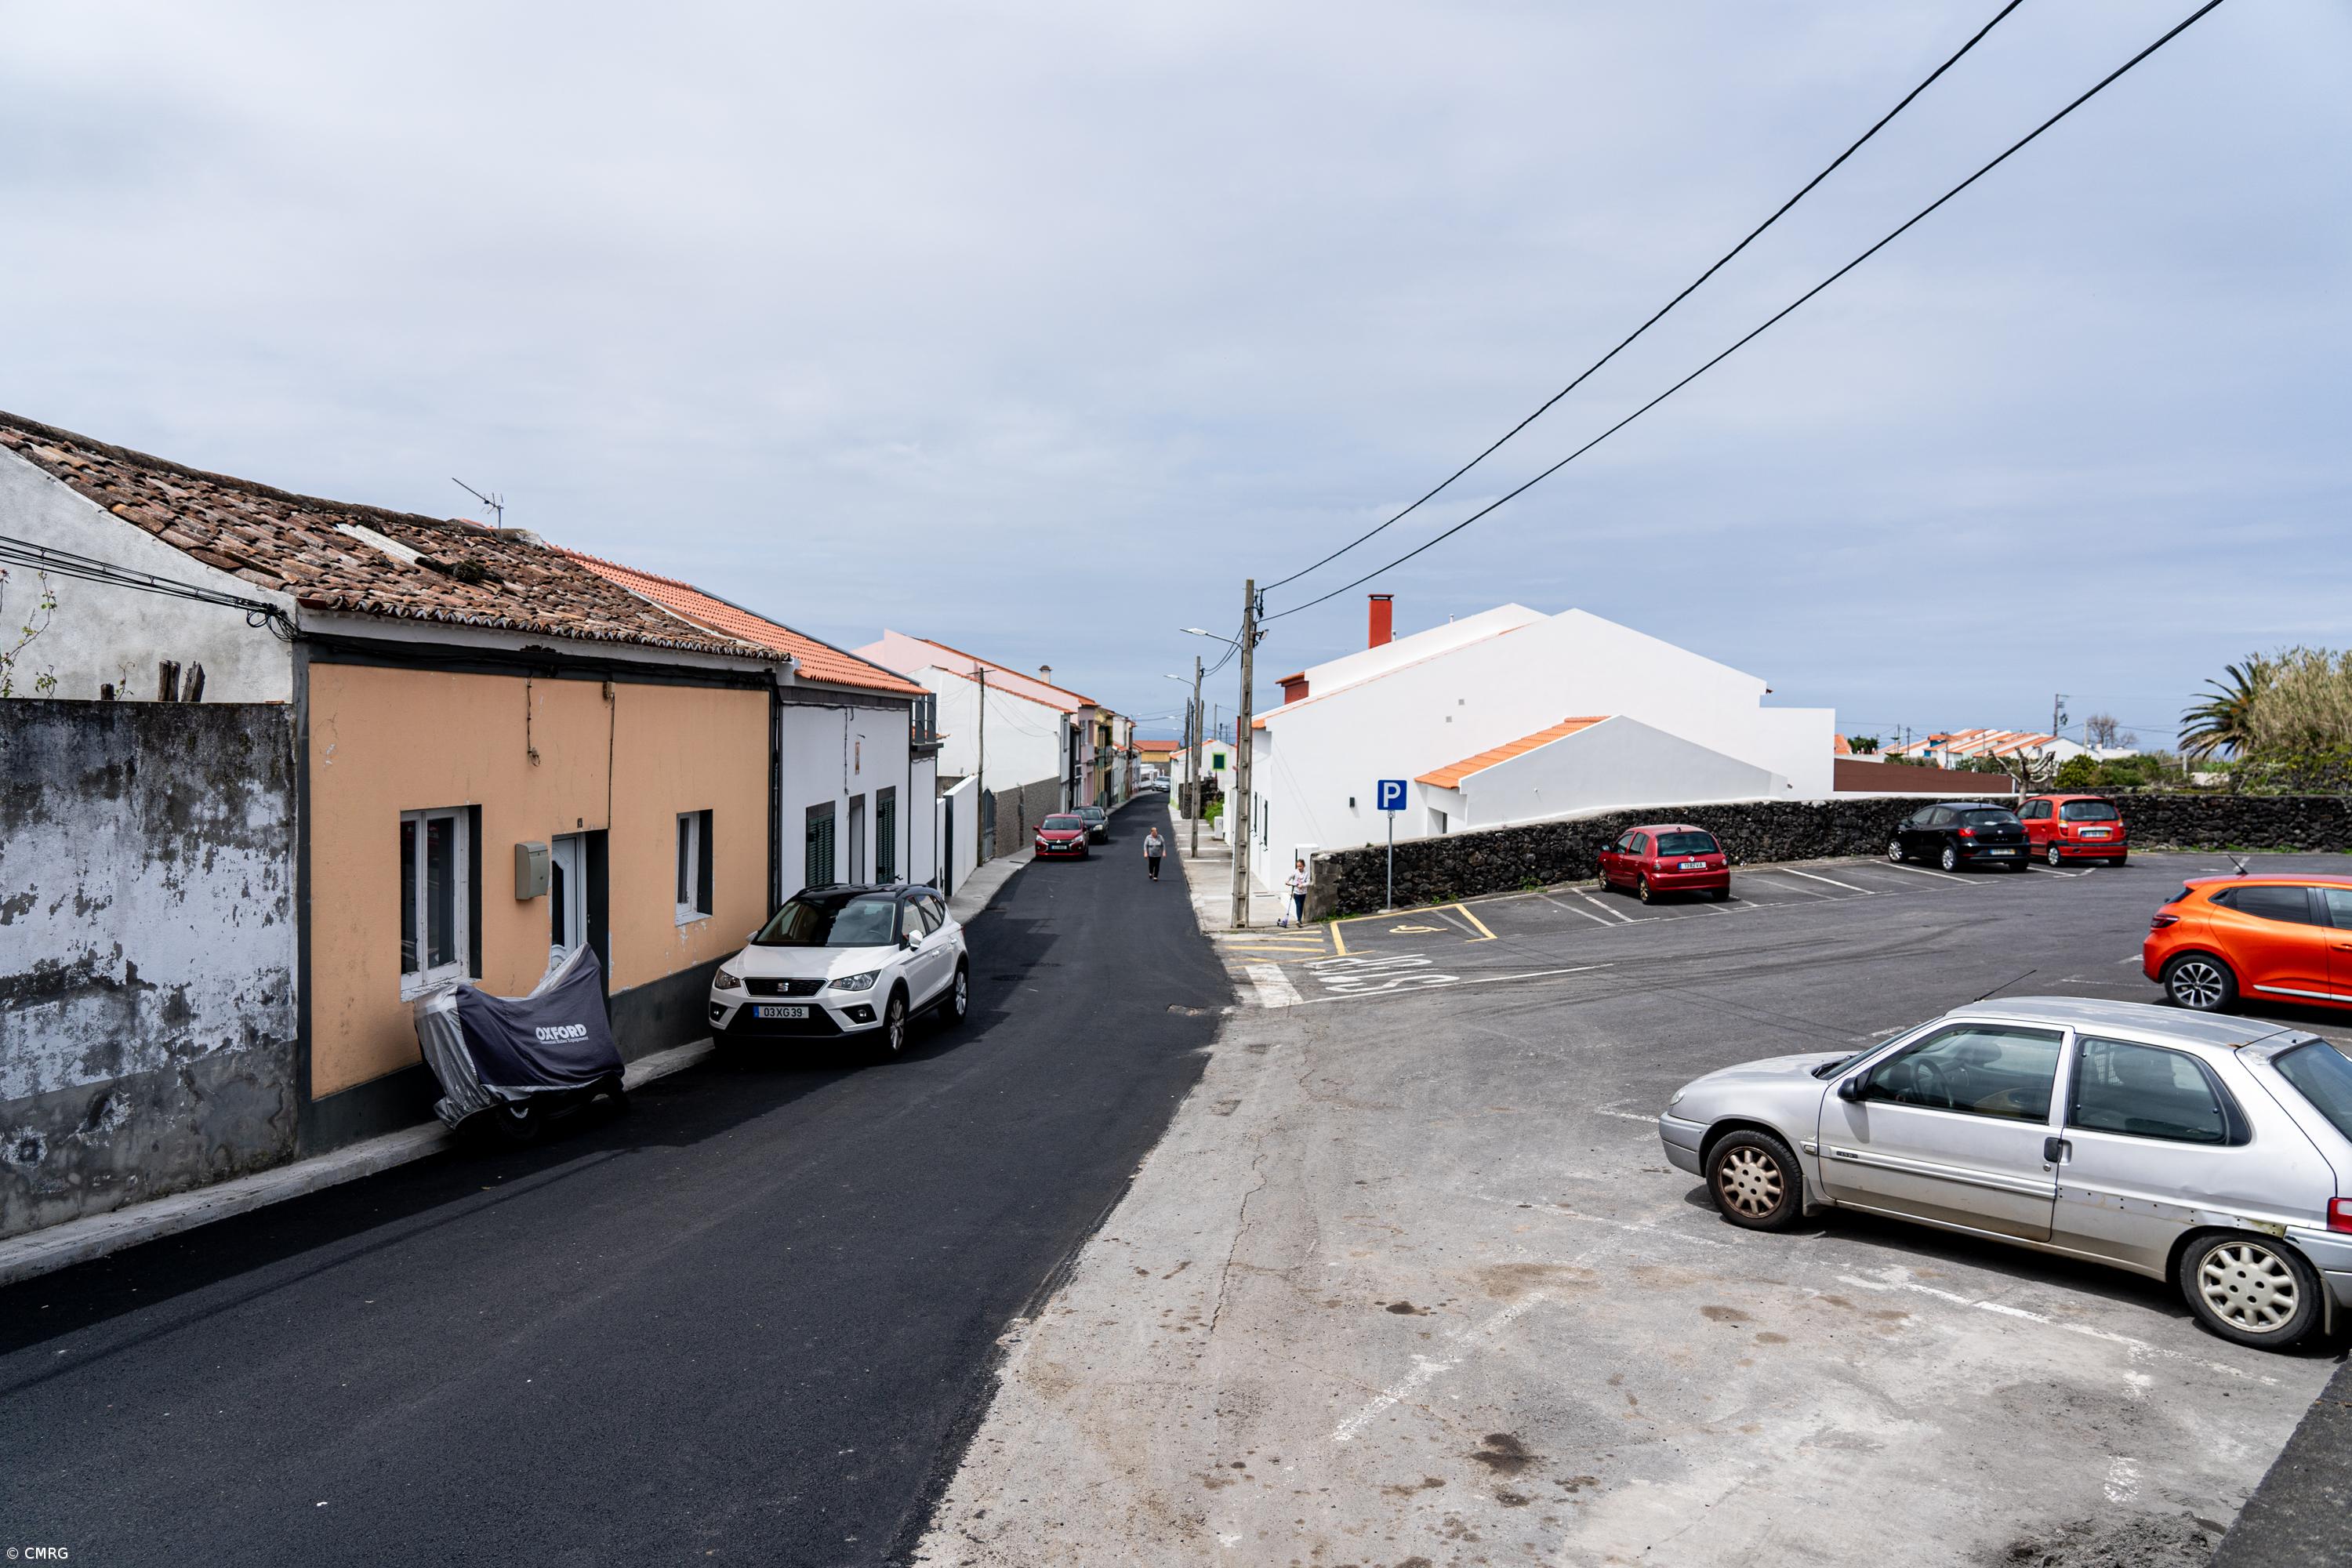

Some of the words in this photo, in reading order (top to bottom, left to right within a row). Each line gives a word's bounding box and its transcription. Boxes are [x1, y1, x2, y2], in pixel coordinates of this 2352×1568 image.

[1383, 782, 1401, 808] P
[1303, 953, 1461, 993] STOP
[764, 1007, 775, 1017] 03
[776, 1007, 789, 1017] XG
[791, 1007, 803, 1017] 39
[535, 1024, 587, 1041] OXFORD
